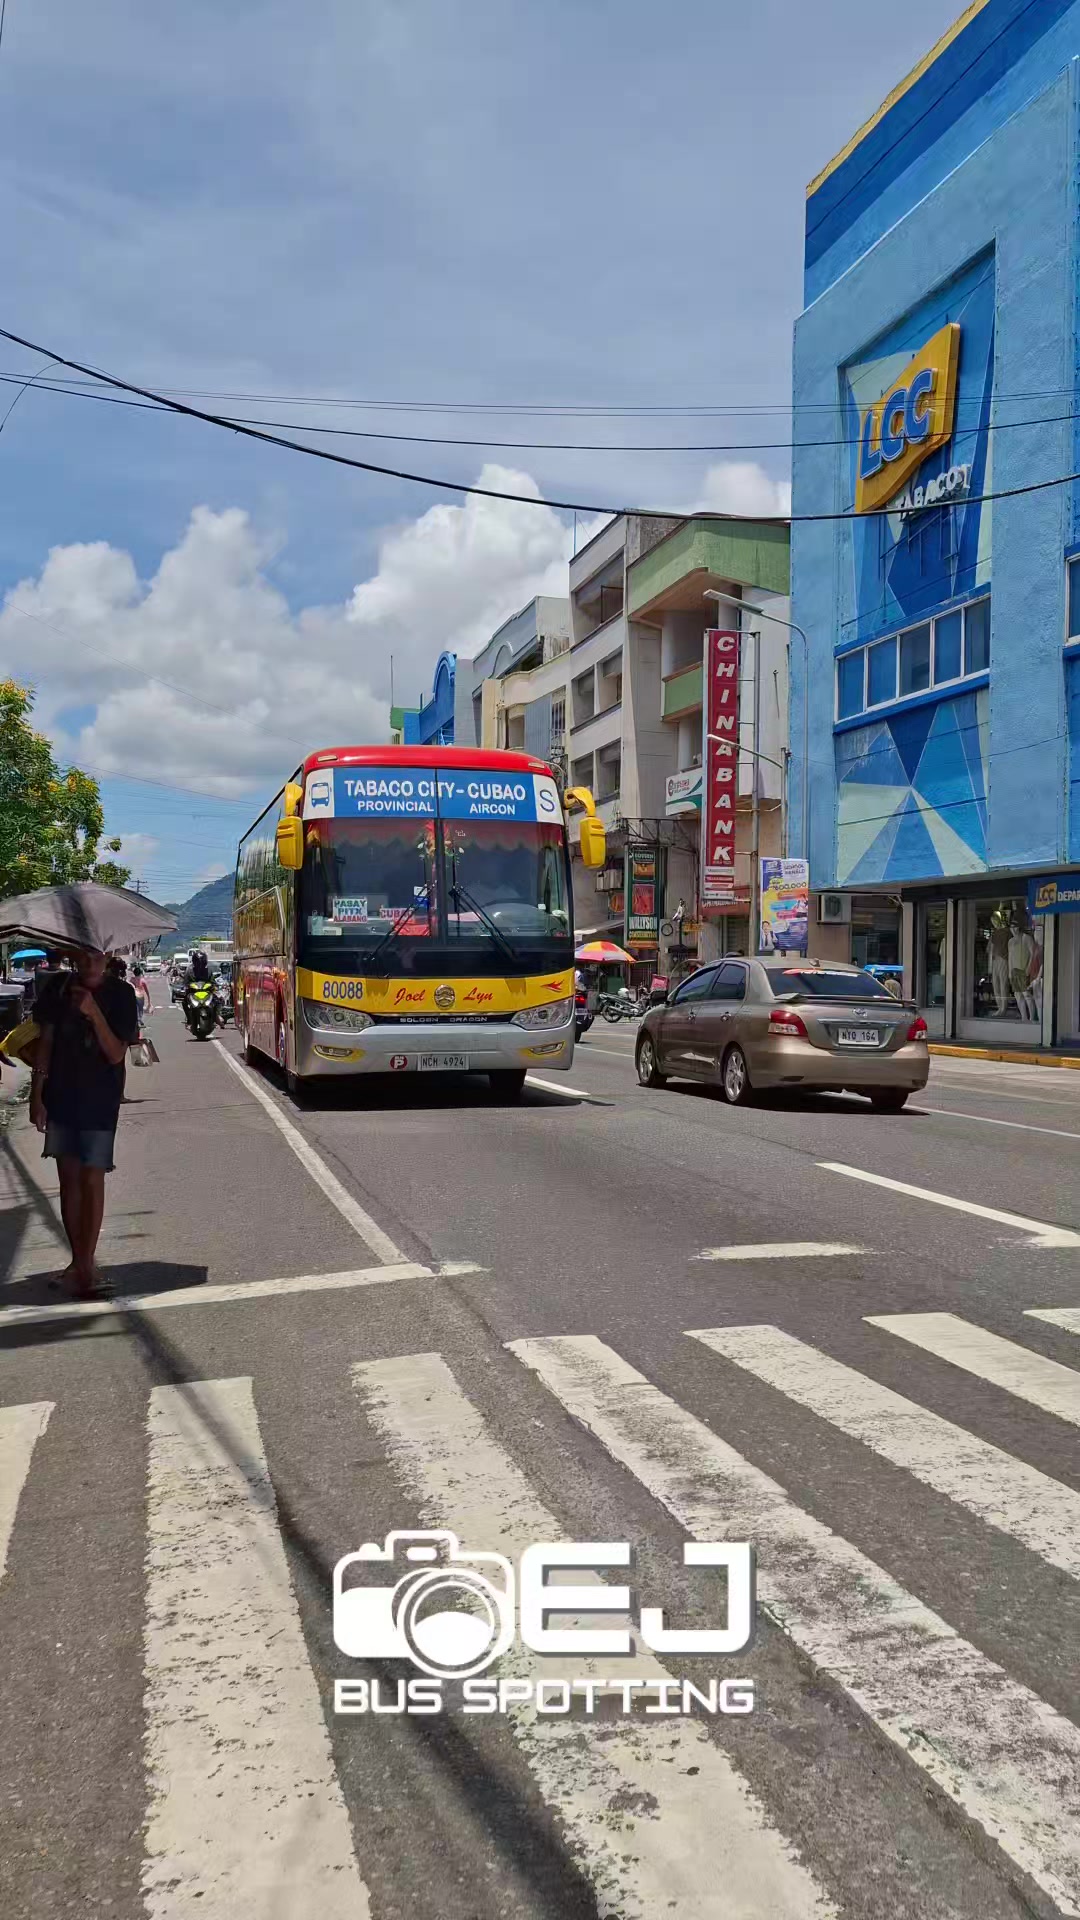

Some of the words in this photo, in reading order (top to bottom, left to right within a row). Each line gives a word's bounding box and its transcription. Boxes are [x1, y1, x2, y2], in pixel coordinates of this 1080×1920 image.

[860, 368, 937, 480] LCC
[344, 780, 414, 797] TABACO
[357, 801, 434, 811] PROVINCIAL
[469, 803, 516, 815] AIRCON
[540, 789, 555, 812] S
[322, 980, 364, 1000] 80088
[394, 987, 426, 1006] Joel
[462, 987, 494, 1004] Lyn
[443, 1057, 464, 1067] 4924
